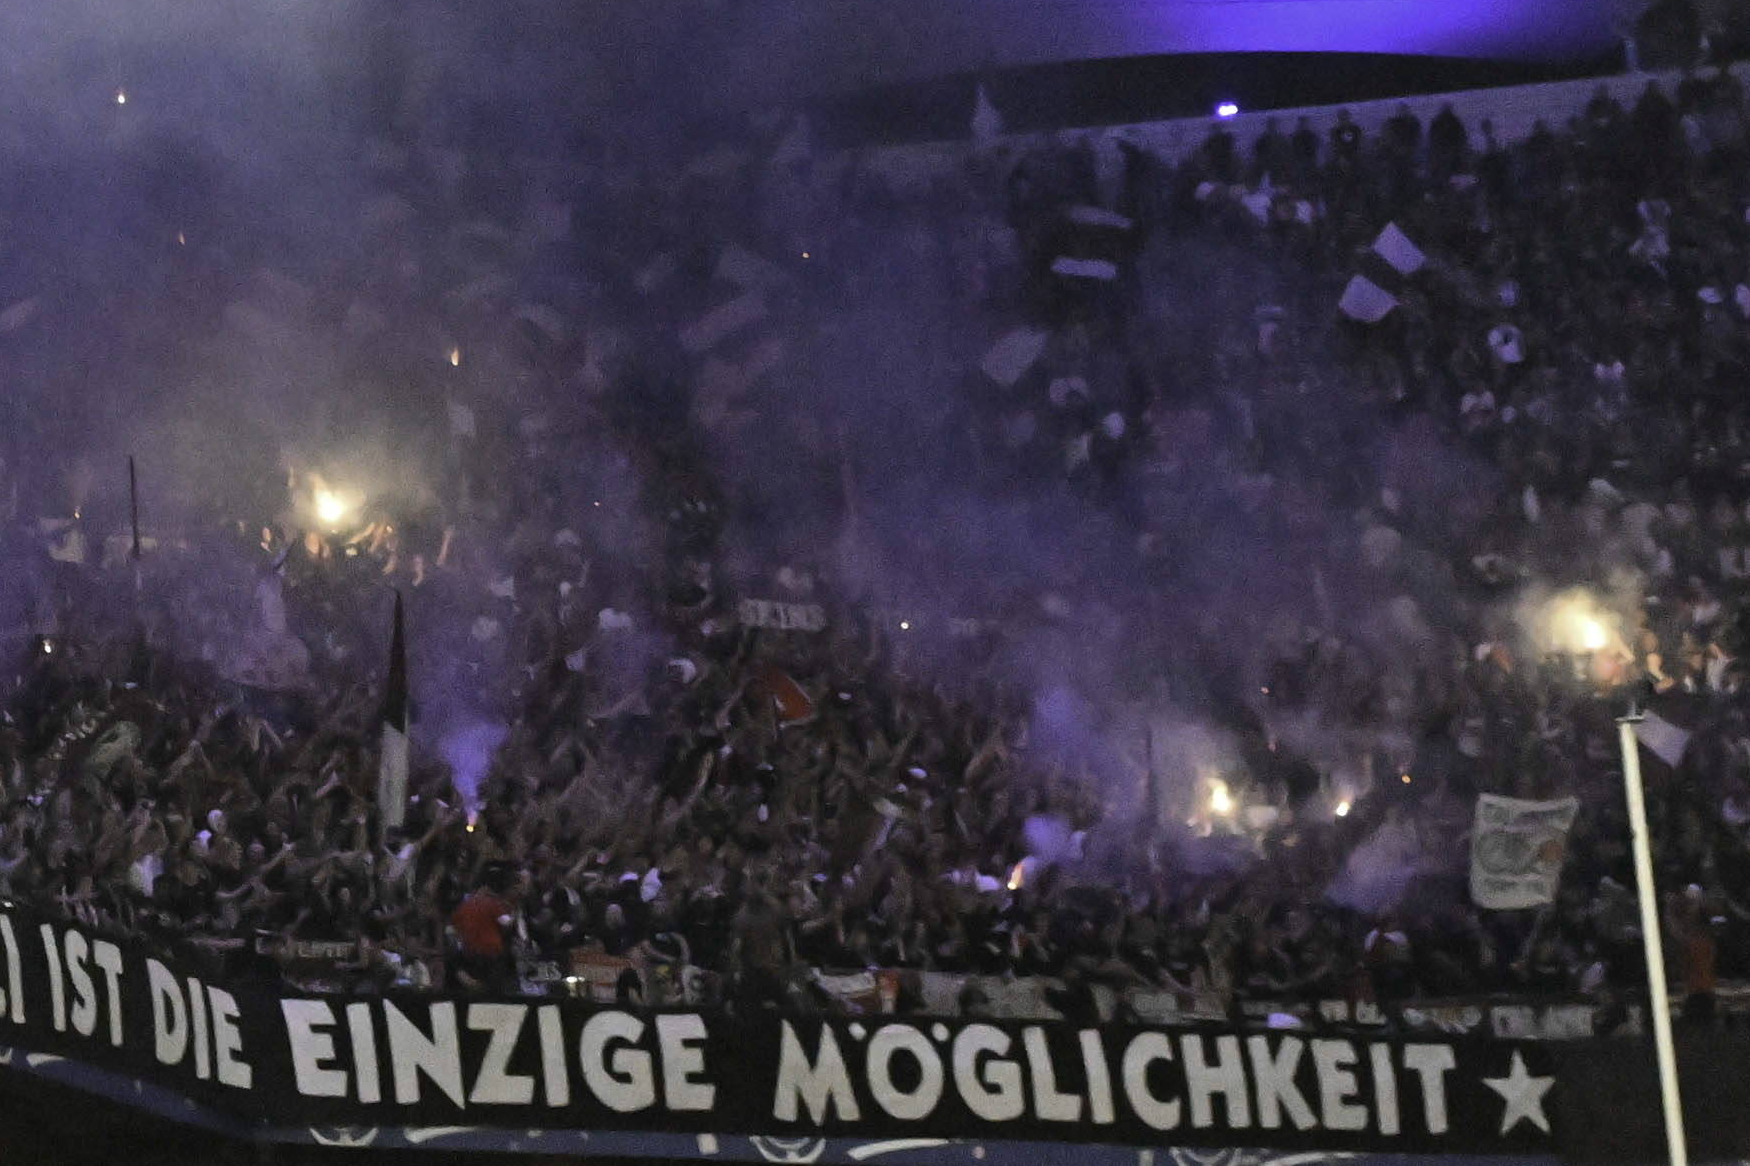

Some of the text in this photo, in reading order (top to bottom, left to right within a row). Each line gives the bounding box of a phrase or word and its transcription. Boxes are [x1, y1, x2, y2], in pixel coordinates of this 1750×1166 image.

[39, 923, 124, 1048] IST
[146, 957, 252, 1090] DIE
[279, 997, 716, 1113] EINZIGE
[772, 1019, 1456, 1135] MÖGLICHKEIT
